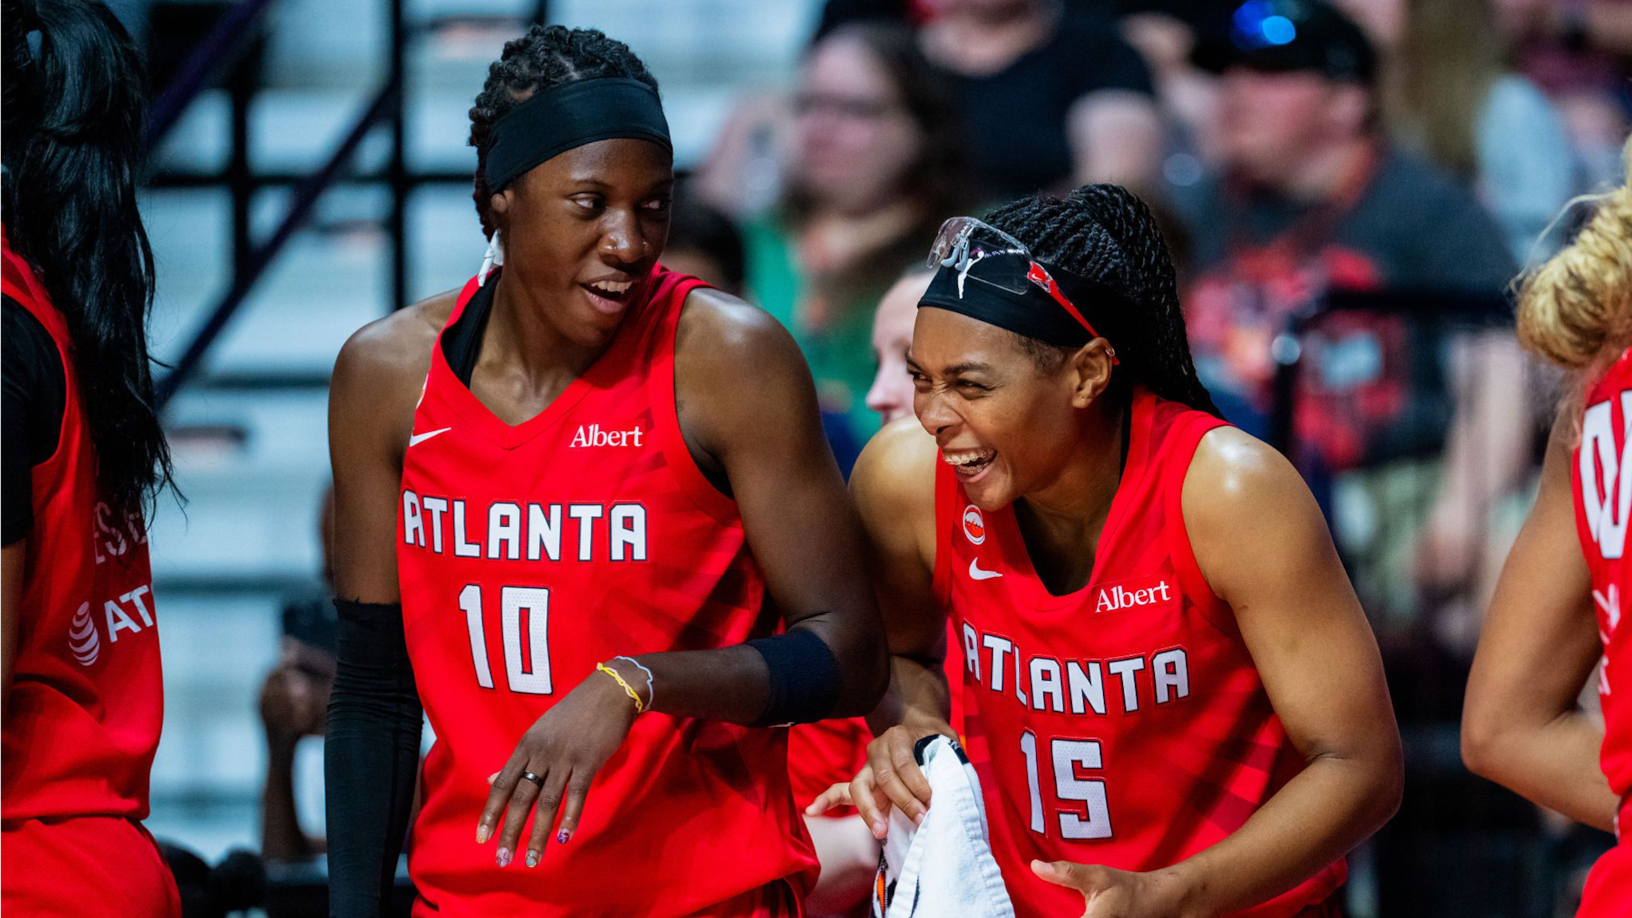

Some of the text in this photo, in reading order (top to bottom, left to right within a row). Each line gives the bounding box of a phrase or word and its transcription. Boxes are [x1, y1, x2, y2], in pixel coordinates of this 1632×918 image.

[569, 424, 643, 447] Albert
[402, 488, 648, 562] ATLANTA
[1094, 580, 1171, 613] Albert
[458, 583, 553, 695] 10
[962, 620, 1190, 715] ATLANTA
[1020, 729, 1114, 841] 15
